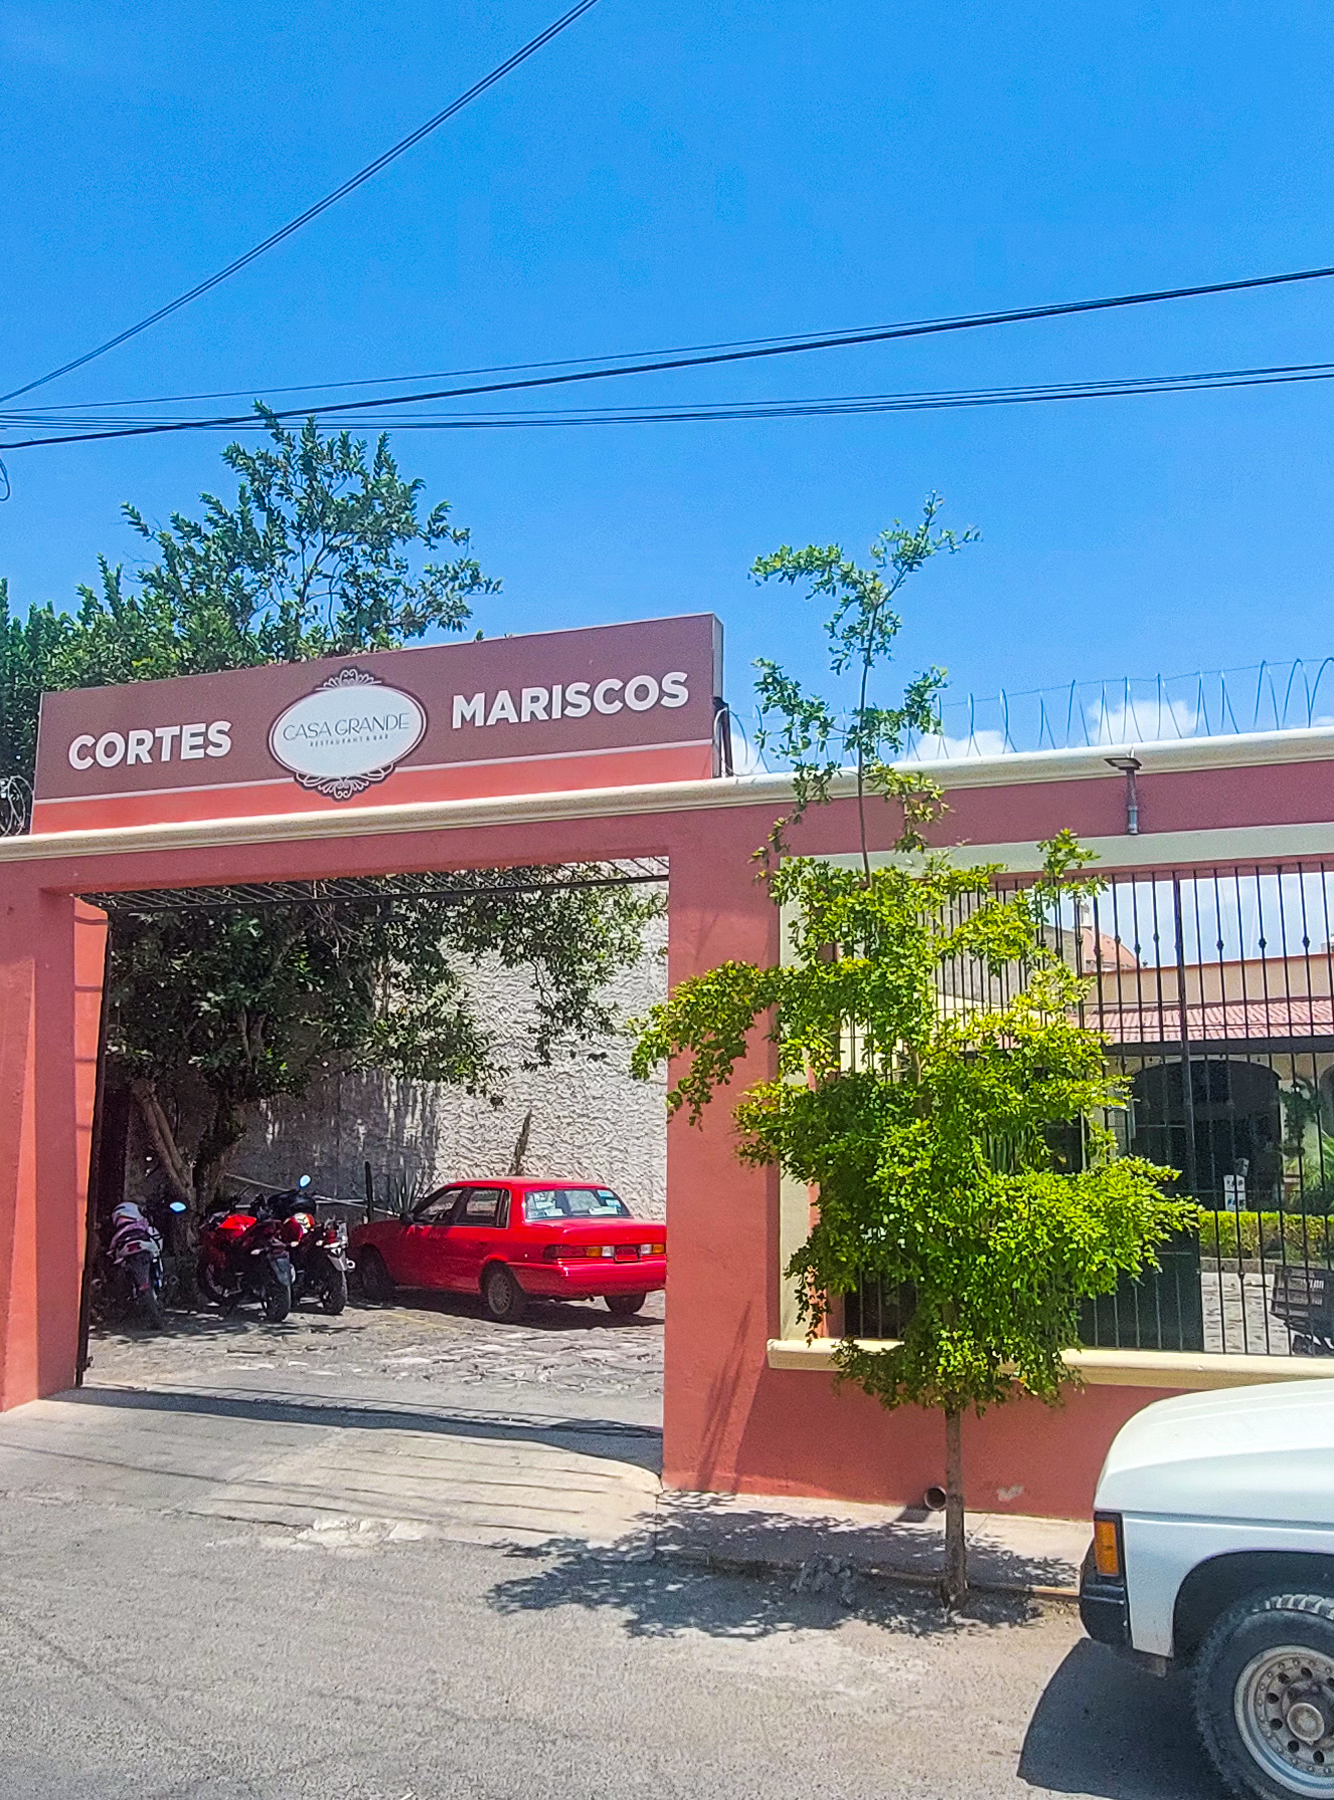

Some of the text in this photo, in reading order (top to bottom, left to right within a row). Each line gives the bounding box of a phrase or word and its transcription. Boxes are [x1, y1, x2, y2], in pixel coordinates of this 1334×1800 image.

[452, 671, 689, 729] MARISCOS
[68, 720, 233, 770] CORTES
[283, 713, 410, 741] CASA GRANDE
